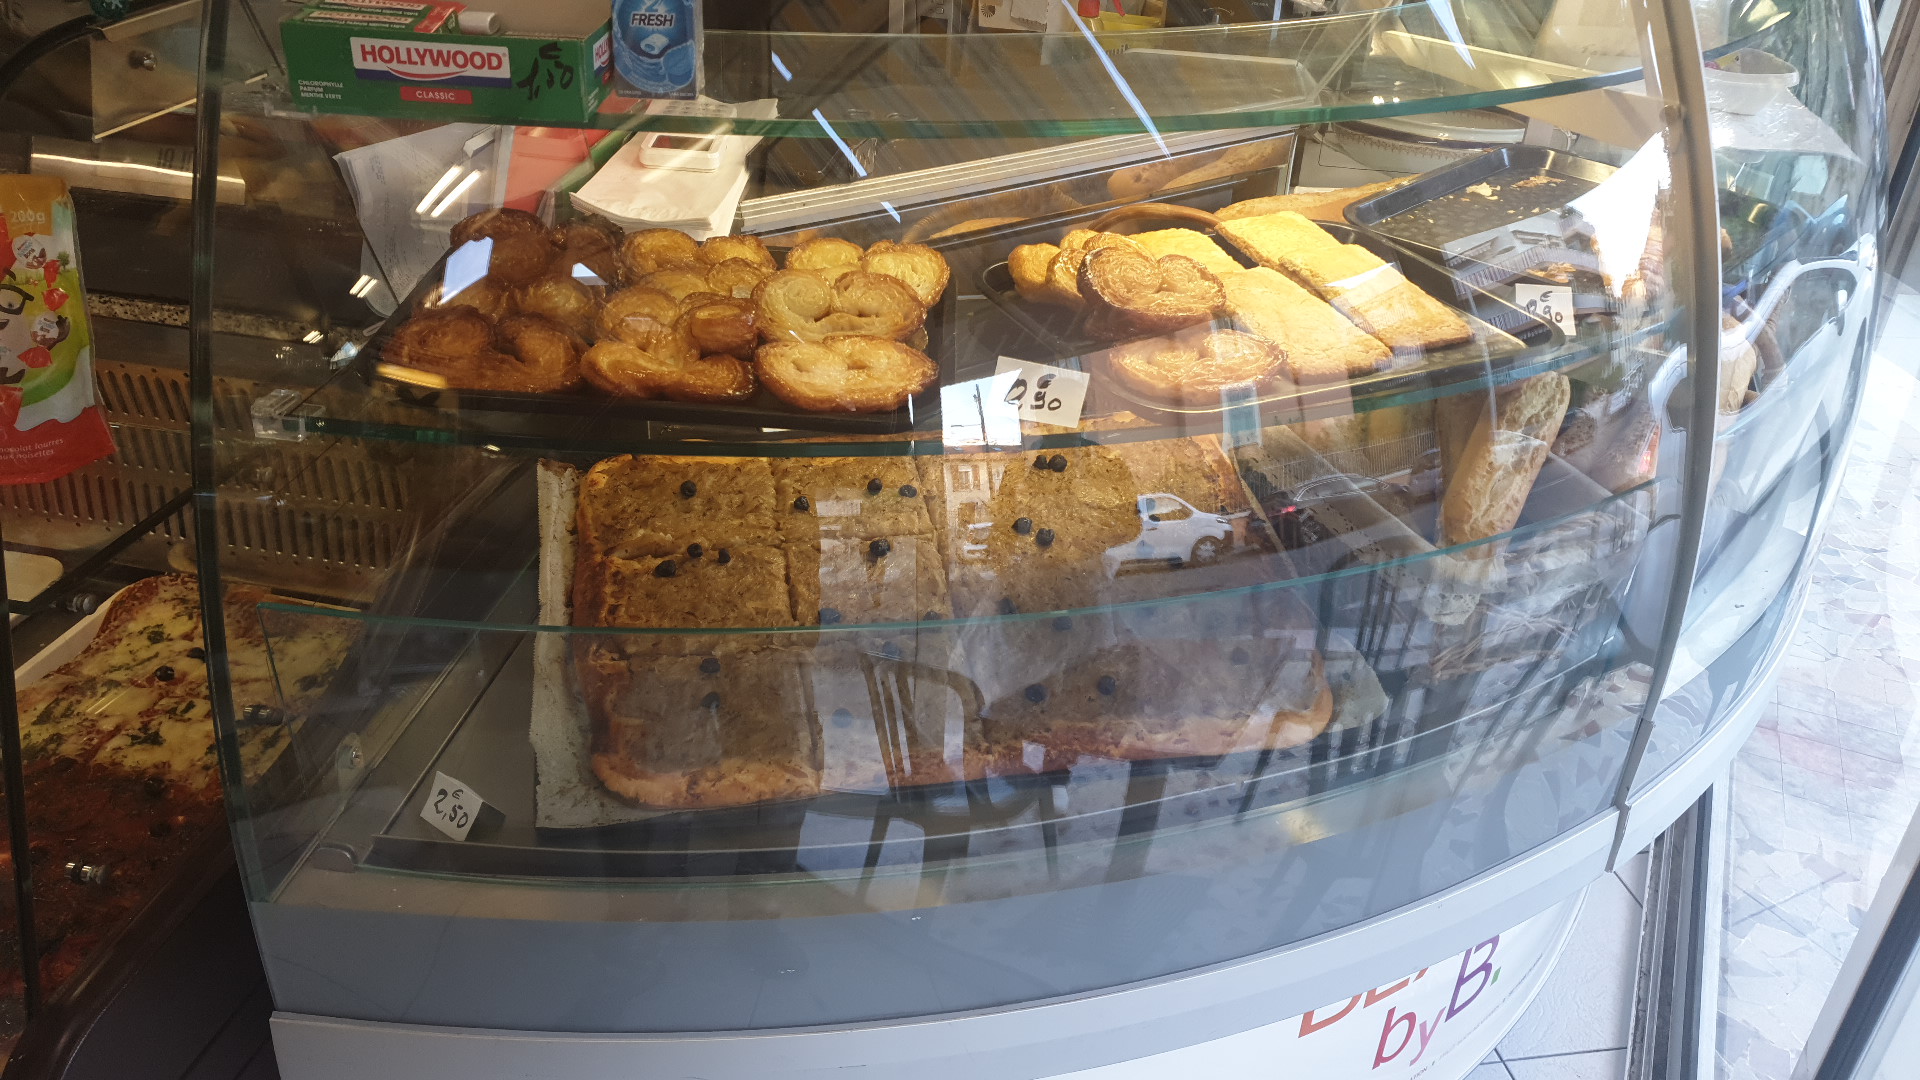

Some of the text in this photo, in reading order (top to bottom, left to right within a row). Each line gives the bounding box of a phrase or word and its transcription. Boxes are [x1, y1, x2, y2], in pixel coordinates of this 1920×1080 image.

[631, 13, 674, 27] FRESH
[360, 44, 503, 71] HOLLYWOOD
[415, 90, 455, 101] CLASSIC
